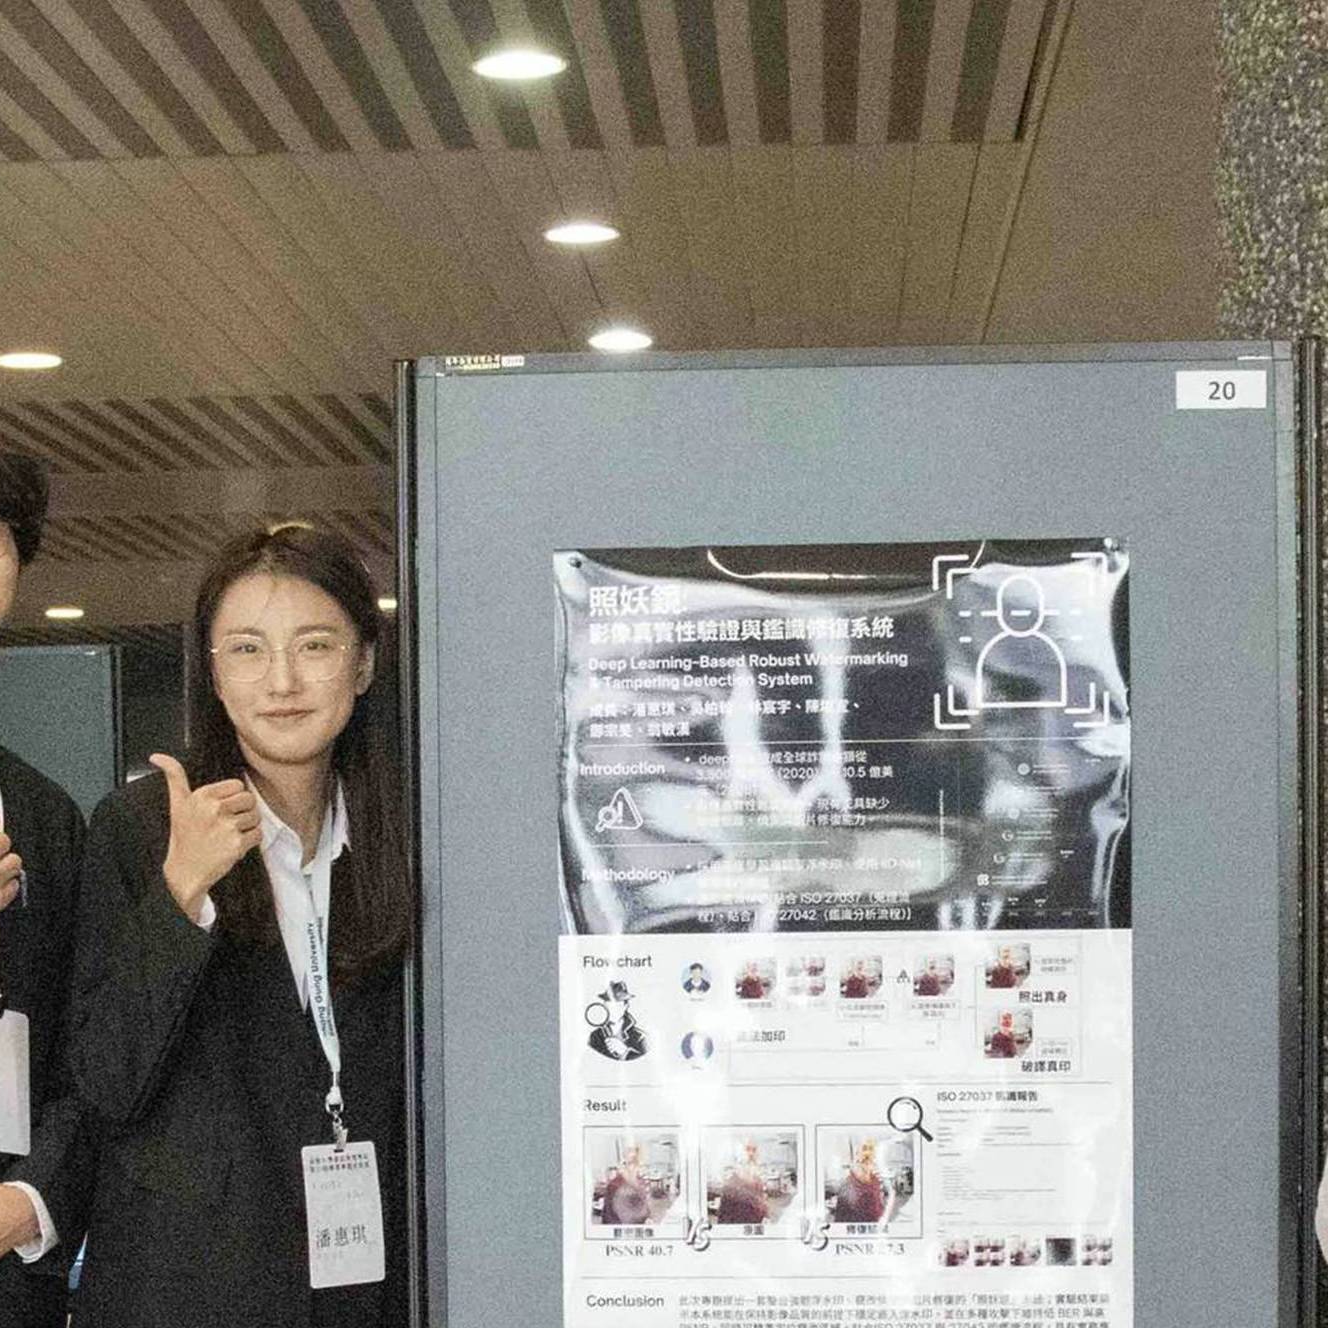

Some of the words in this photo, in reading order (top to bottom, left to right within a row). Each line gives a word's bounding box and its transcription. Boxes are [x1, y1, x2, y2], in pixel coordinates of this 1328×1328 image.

[1208, 381, 1236, 400] 20
[588, 657, 626, 674] Deep
[629, 654, 745, 672] Learning-Based
[749, 653, 801, 668] Robust
[603, 673, 681, 692] Tampering
[758, 672, 813, 689] System
[580, 762, 665, 776] Introduction
[616, 954, 653, 968] chart
[583, 1099, 627, 1112] Result
[878, 1243, 905, 1256] 7.3
[586, 1294, 665, 1308] Conclusion
